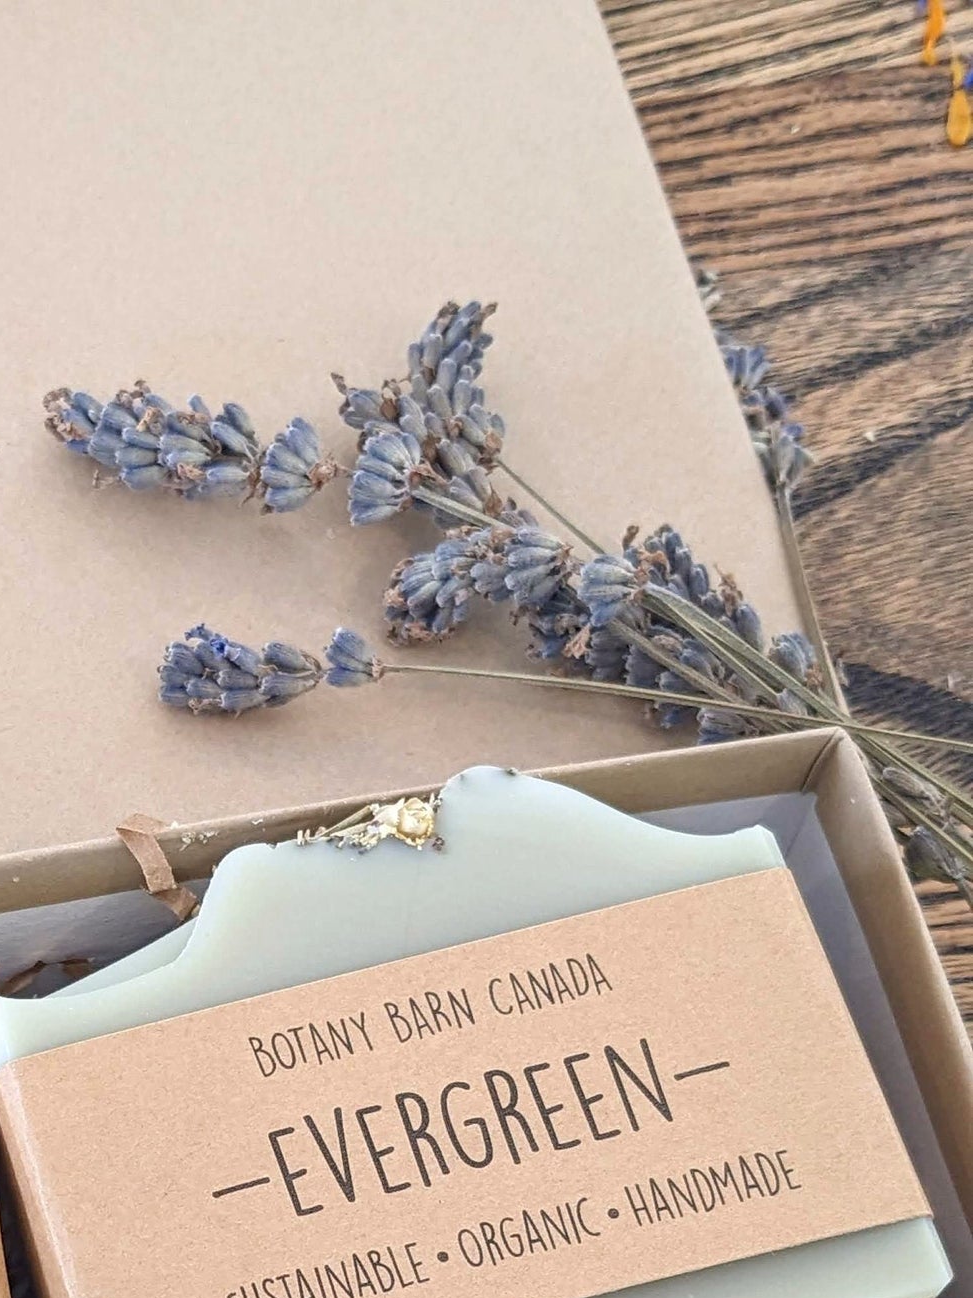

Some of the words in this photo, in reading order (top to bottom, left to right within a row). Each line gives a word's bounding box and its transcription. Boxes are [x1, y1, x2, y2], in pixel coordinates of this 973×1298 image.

[248, 1011, 374, 1078] BOTANY
[383, 988, 476, 1044] BARN
[488, 953, 613, 1016] CANADA
[457, 1197, 602, 1268] ORGANIC
[623, 1149, 802, 1227] HANDMADE
